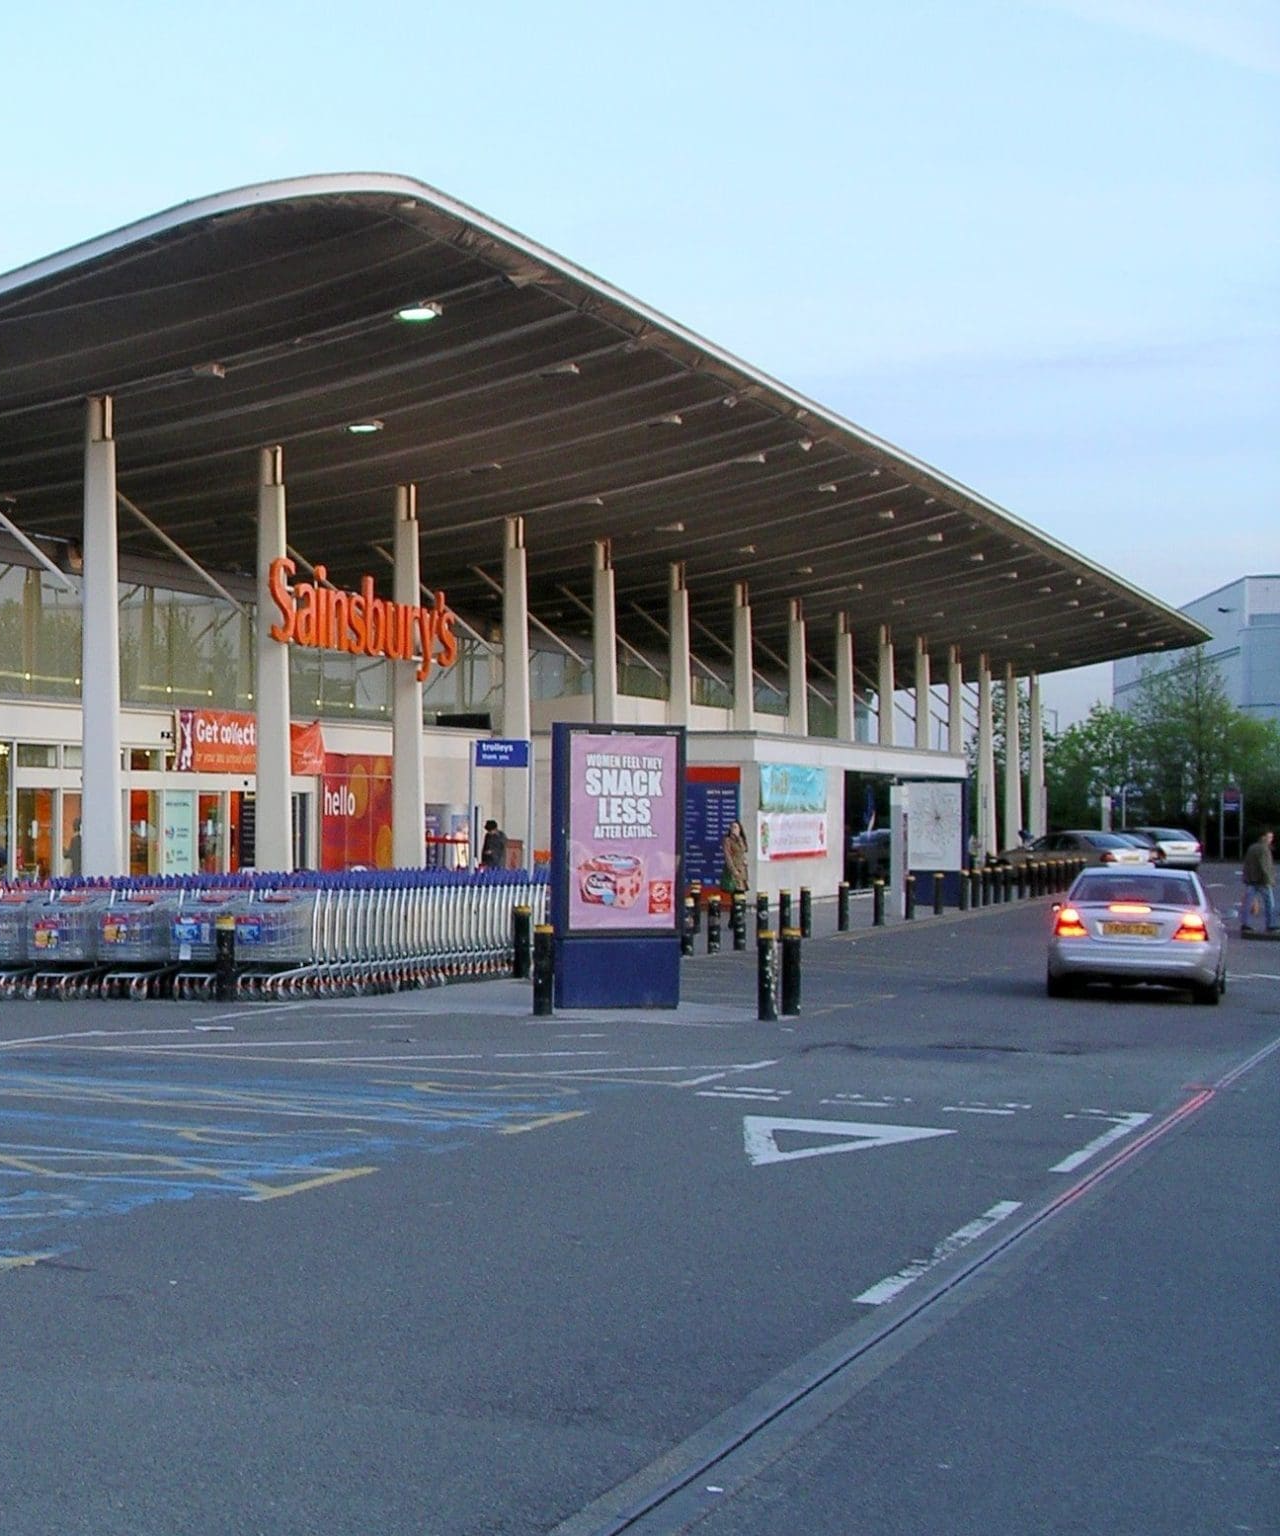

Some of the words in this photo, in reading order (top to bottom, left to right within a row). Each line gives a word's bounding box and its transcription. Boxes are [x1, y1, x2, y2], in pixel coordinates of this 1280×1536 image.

[268, 557, 458, 682] Sainsbury's
[195, 718, 218, 744] Get
[220, 722, 257, 746] collect
[586, 753, 621, 767] WOMEN
[622, 755, 640, 768] FEEL
[642, 756, 663, 769] THEY
[585, 767, 663, 797] SNACK
[324, 784, 356, 816] hello
[598, 797, 651, 825] LESS
[593, 825, 621, 838] AFTER
